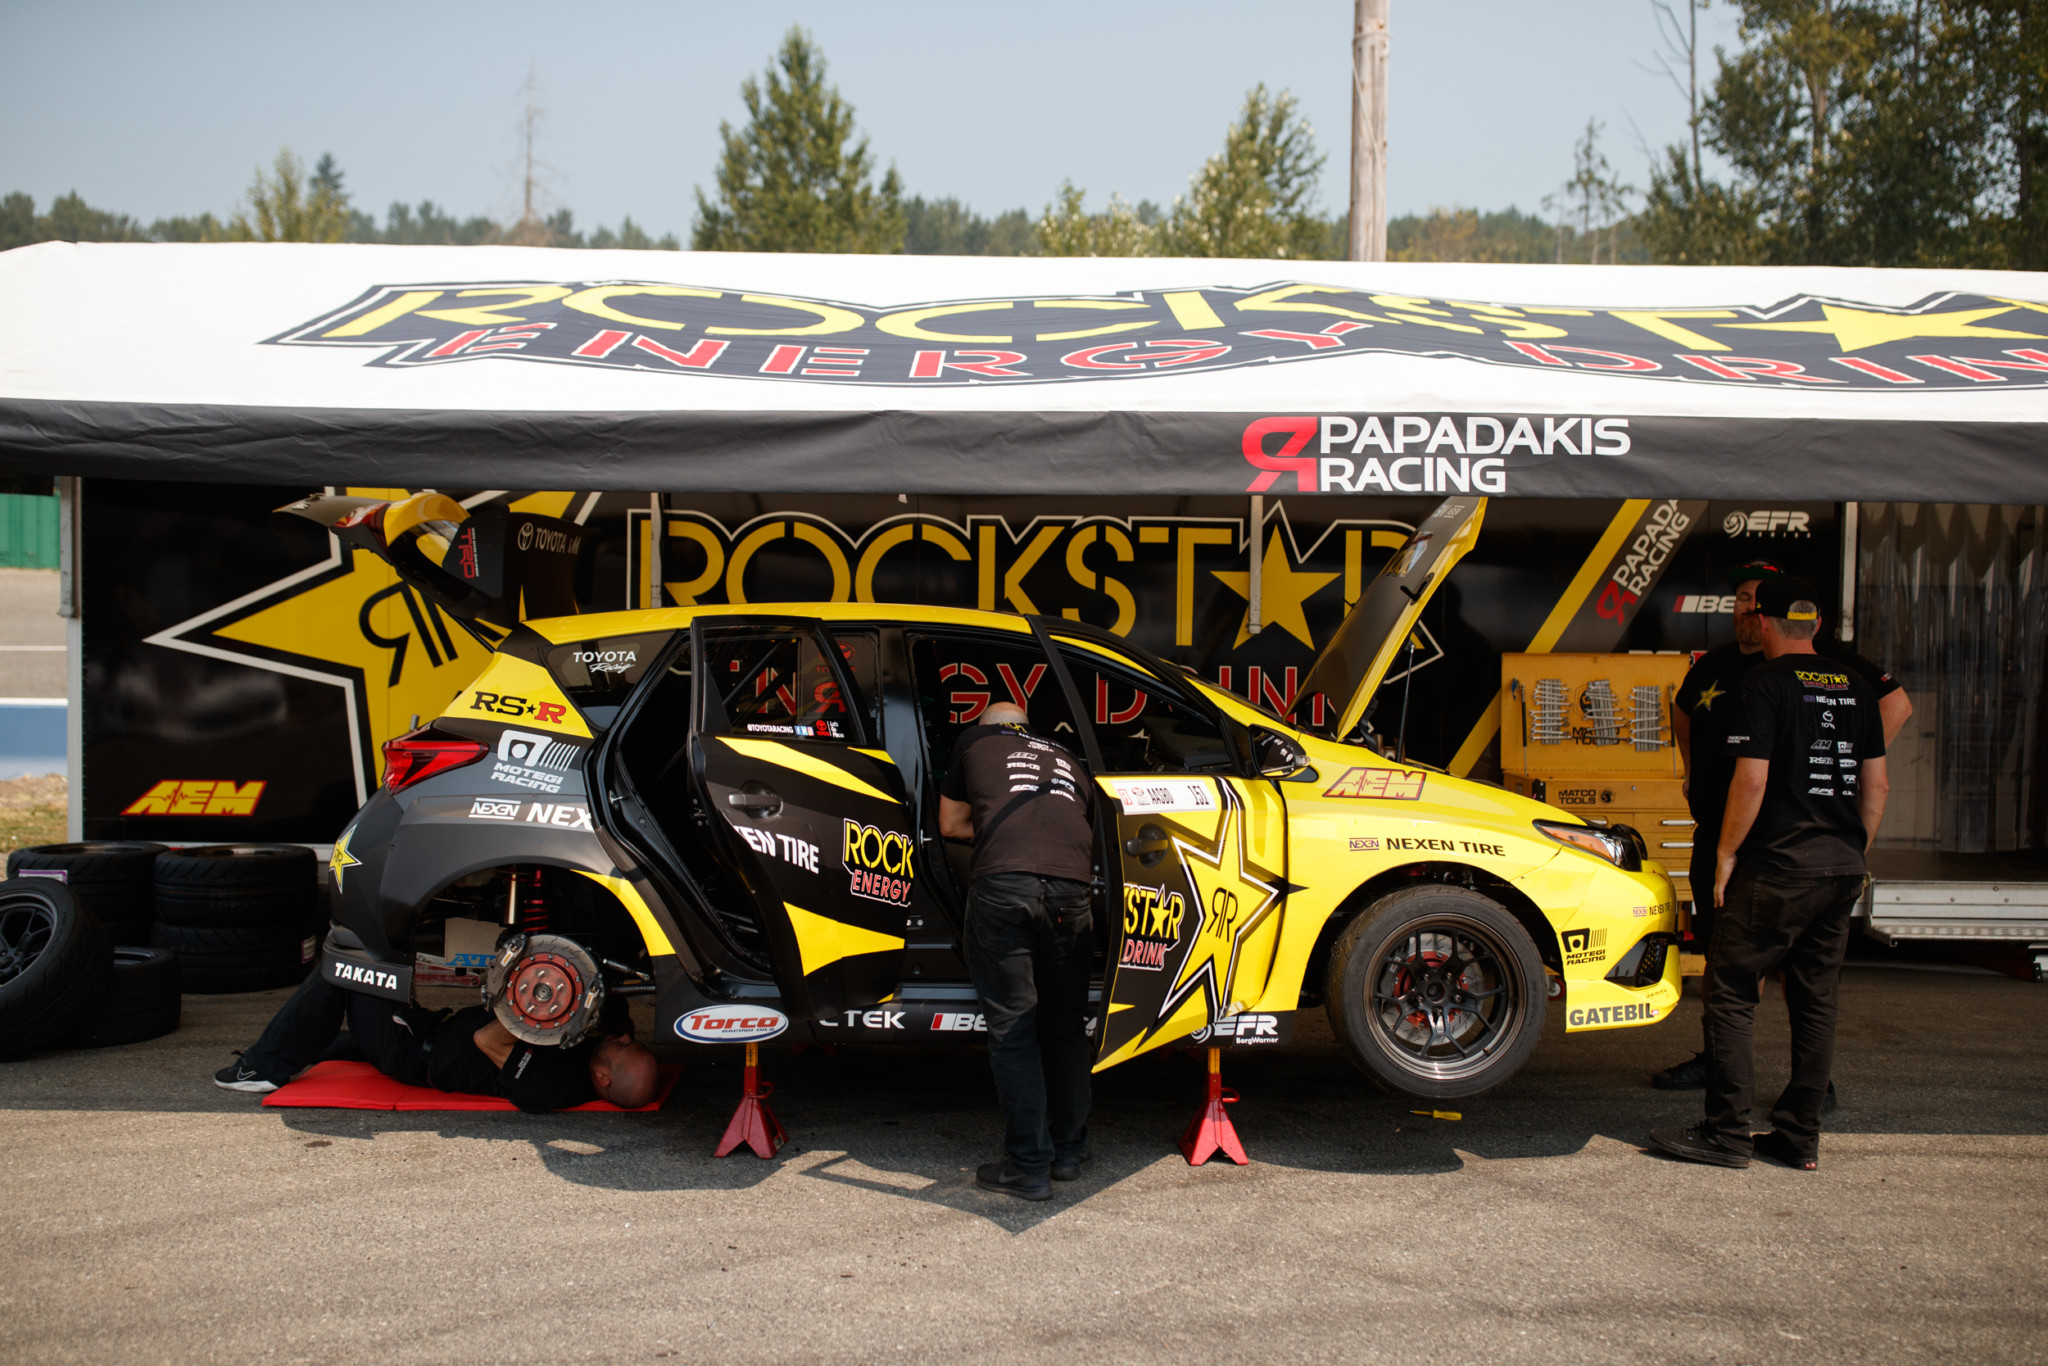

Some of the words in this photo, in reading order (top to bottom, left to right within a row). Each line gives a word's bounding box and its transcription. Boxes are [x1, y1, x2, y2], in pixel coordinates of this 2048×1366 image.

[423, 321, 1374, 379] ENERGY
[1320, 415, 1632, 456] PAPADAKIS
[1320, 456, 1506, 492] RACING
[1746, 510, 1811, 532] EFR
[535, 527, 567, 554] TOYOTA
[458, 528, 477, 579] TRD
[1627, 511, 1691, 596] RACING
[572, 651, 637, 663] TOYOTA
[1838, 697, 1856, 705] TIRE
[490, 771, 562, 794] RACING
[493, 762, 564, 785] MOTEGI
[1322, 767, 1428, 801] AEM
[119, 779, 268, 817] AEM
[1187, 785, 1210, 805] 151
[1558, 789, 1597, 797] MATCO
[1558, 797, 1597, 805] TOOLS
[469, 799, 521, 819] NEXEN
[776, 833, 820, 875] TIRE
[843, 820, 915, 879] ROCK
[1350, 838, 1380, 851] NEXEN
[1386, 838, 1456, 852] NEXEN
[1459, 841, 1507, 857] TIRE
[851, 869, 912, 902] ENERGY
[1123, 886, 1185, 941] STAR
[1122, 938, 1168, 966] DRINK
[1566, 949, 1606, 960] MOTEGI
[1566, 955, 1606, 965] RACING
[334, 962, 398, 990] TAKATA
[690, 1014, 780, 1031] Torco
[1213, 1014, 1279, 1036] EFR
[1569, 1002, 1655, 1027] GATEBIL
[1236, 1037, 1279, 1045] BorgWarner
